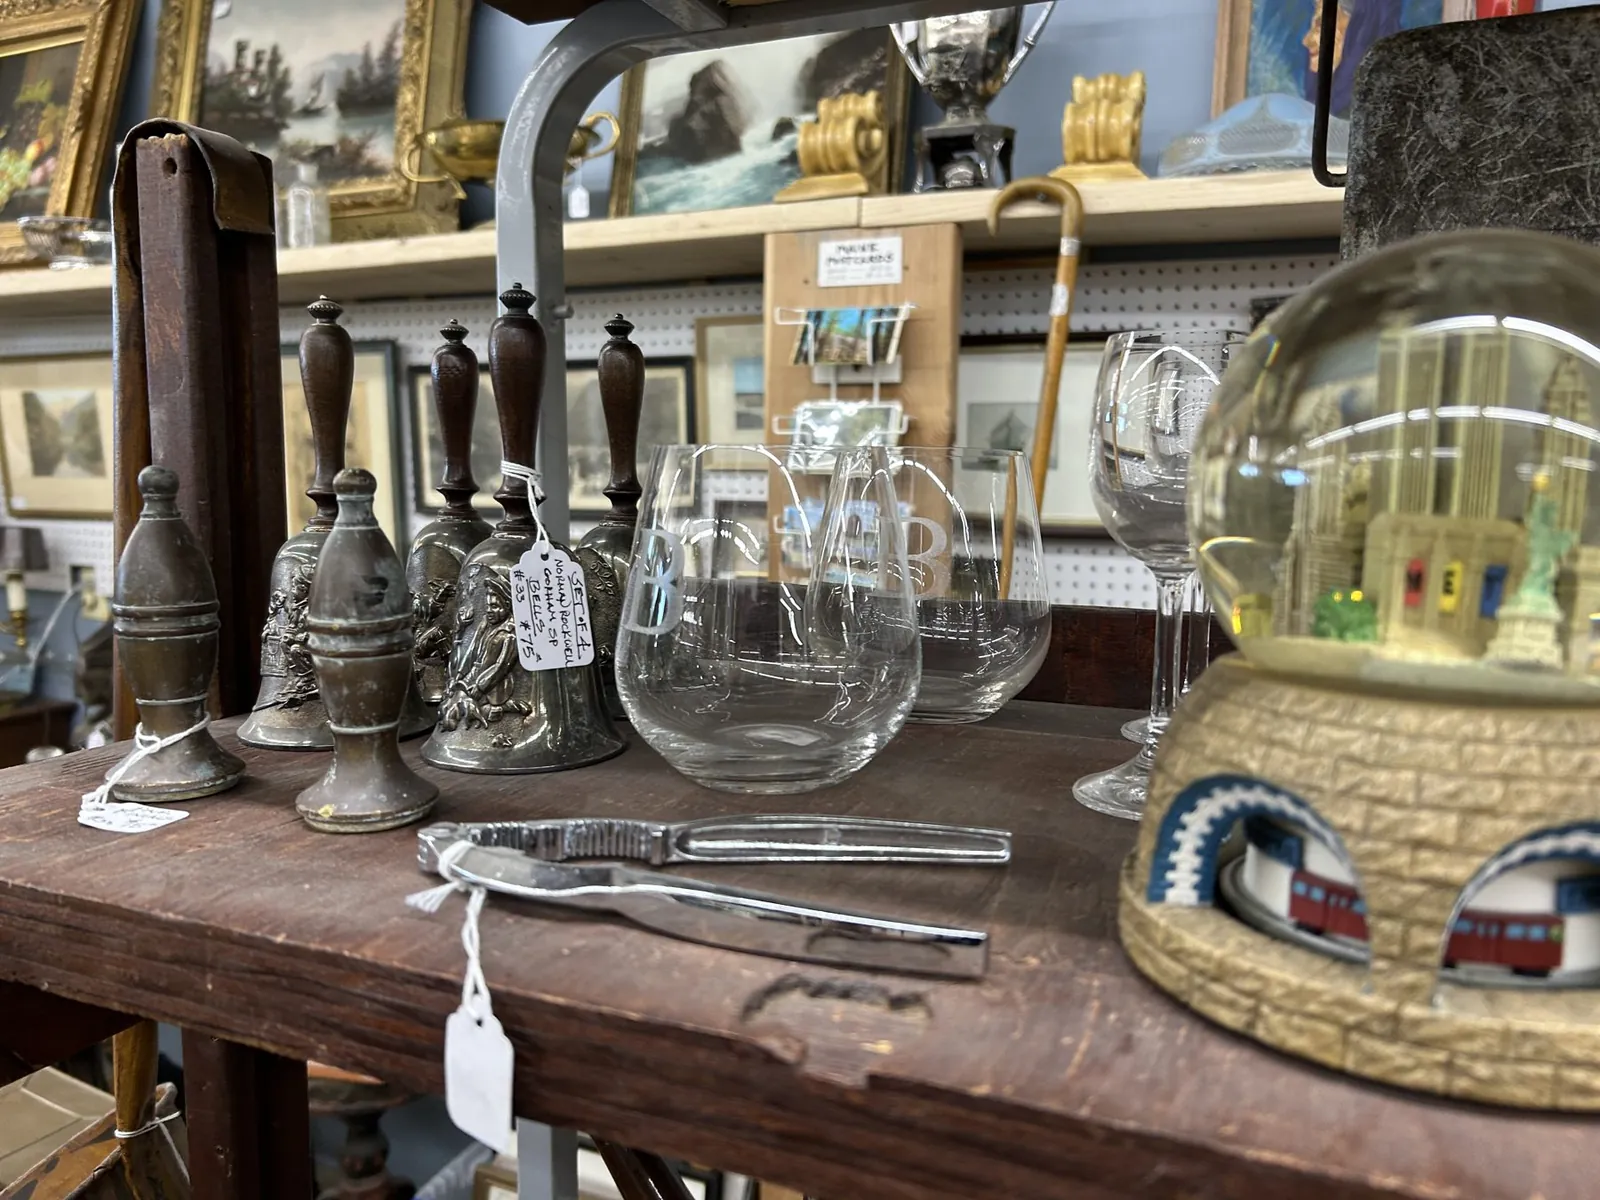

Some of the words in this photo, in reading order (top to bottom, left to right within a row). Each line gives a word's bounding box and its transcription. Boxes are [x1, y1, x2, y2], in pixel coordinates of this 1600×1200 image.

[555, 559, 572, 608] NORMAN
[622, 528, 686, 635] B
[866, 516, 951, 599] B
[529, 576, 546, 633] BELLS
[544, 568, 557, 622] GORHAM
[571, 570, 585, 614] SET
[548, 628, 559, 647] SP
[560, 610, 574, 667] ROCKWELL
[577, 637, 591, 651] 4
